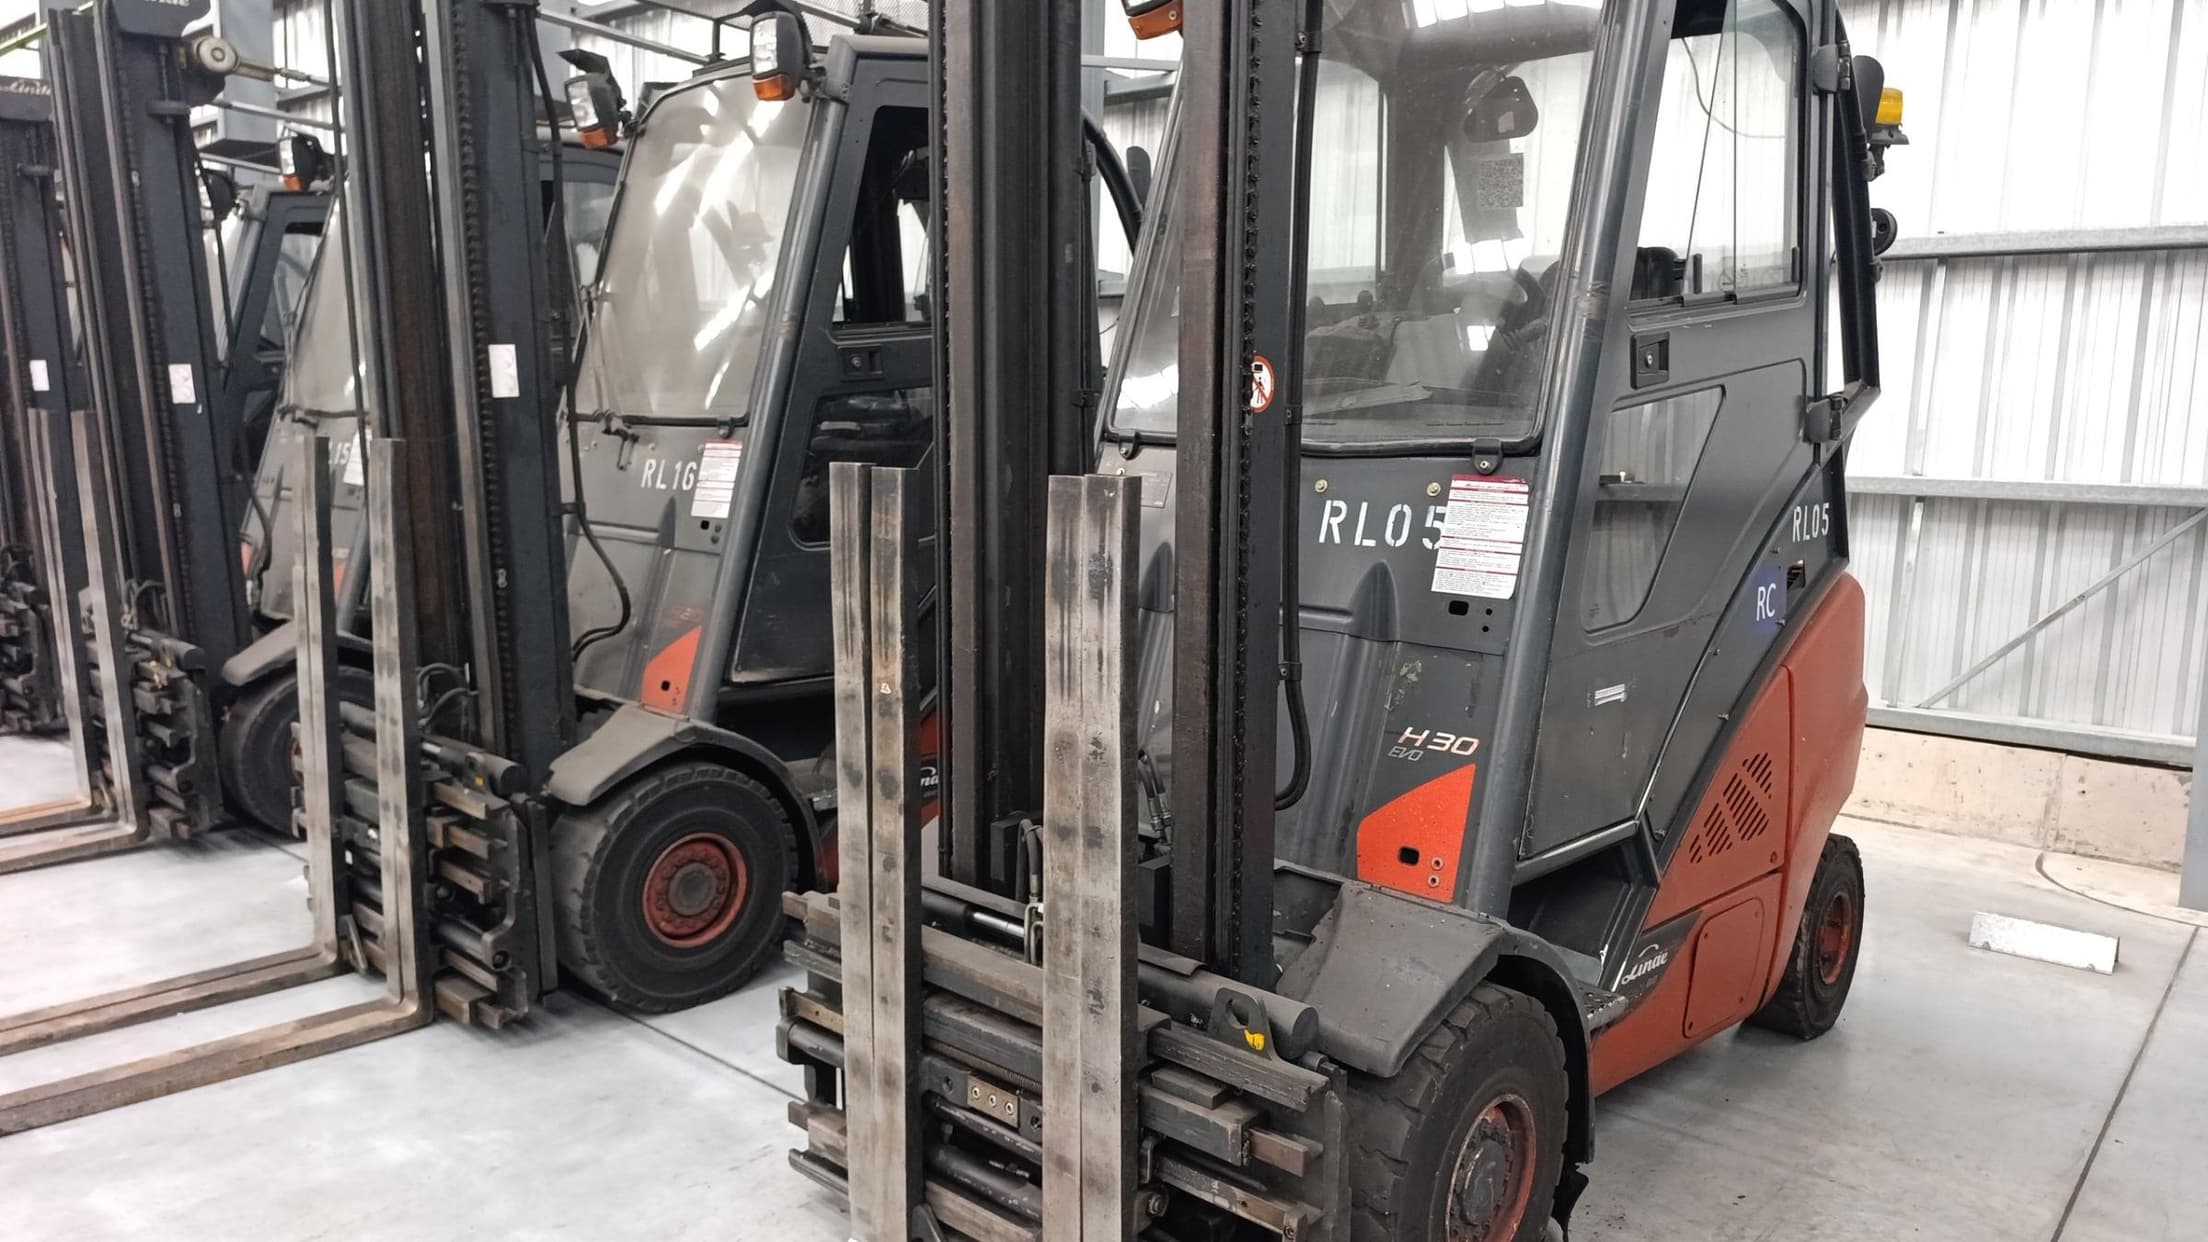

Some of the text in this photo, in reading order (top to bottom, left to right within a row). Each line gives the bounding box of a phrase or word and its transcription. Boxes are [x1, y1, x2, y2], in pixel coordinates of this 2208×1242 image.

[1318, 499, 1447, 550] RL05
[1792, 502, 1830, 542] RL05
[1756, 583, 1776, 621] RC
[1388, 745, 1424, 761] EVO
